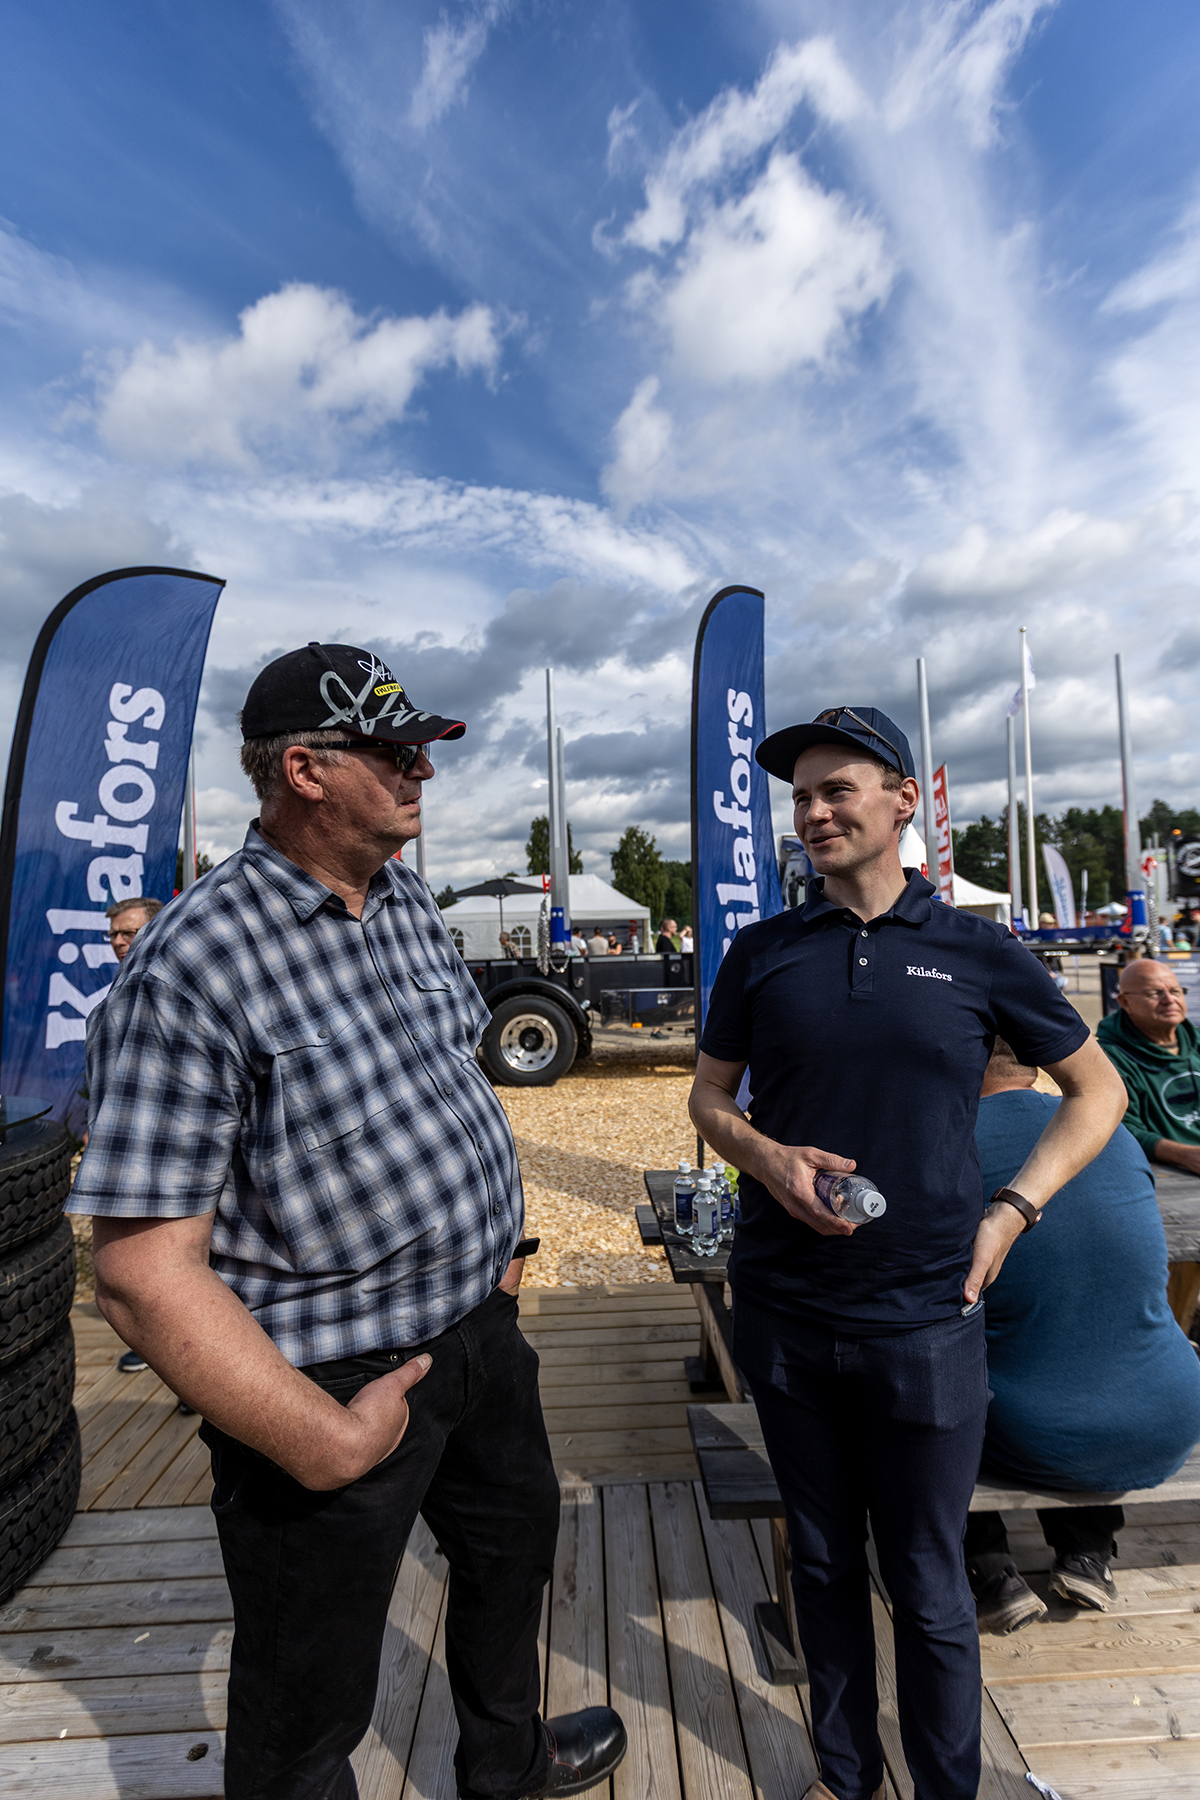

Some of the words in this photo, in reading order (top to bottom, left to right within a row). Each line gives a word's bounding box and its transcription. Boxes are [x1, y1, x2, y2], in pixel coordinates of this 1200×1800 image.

[45, 682, 166, 1050] Kilafors
[713, 688, 761, 957] ilafors
[906, 965, 953, 982] Kilafors
